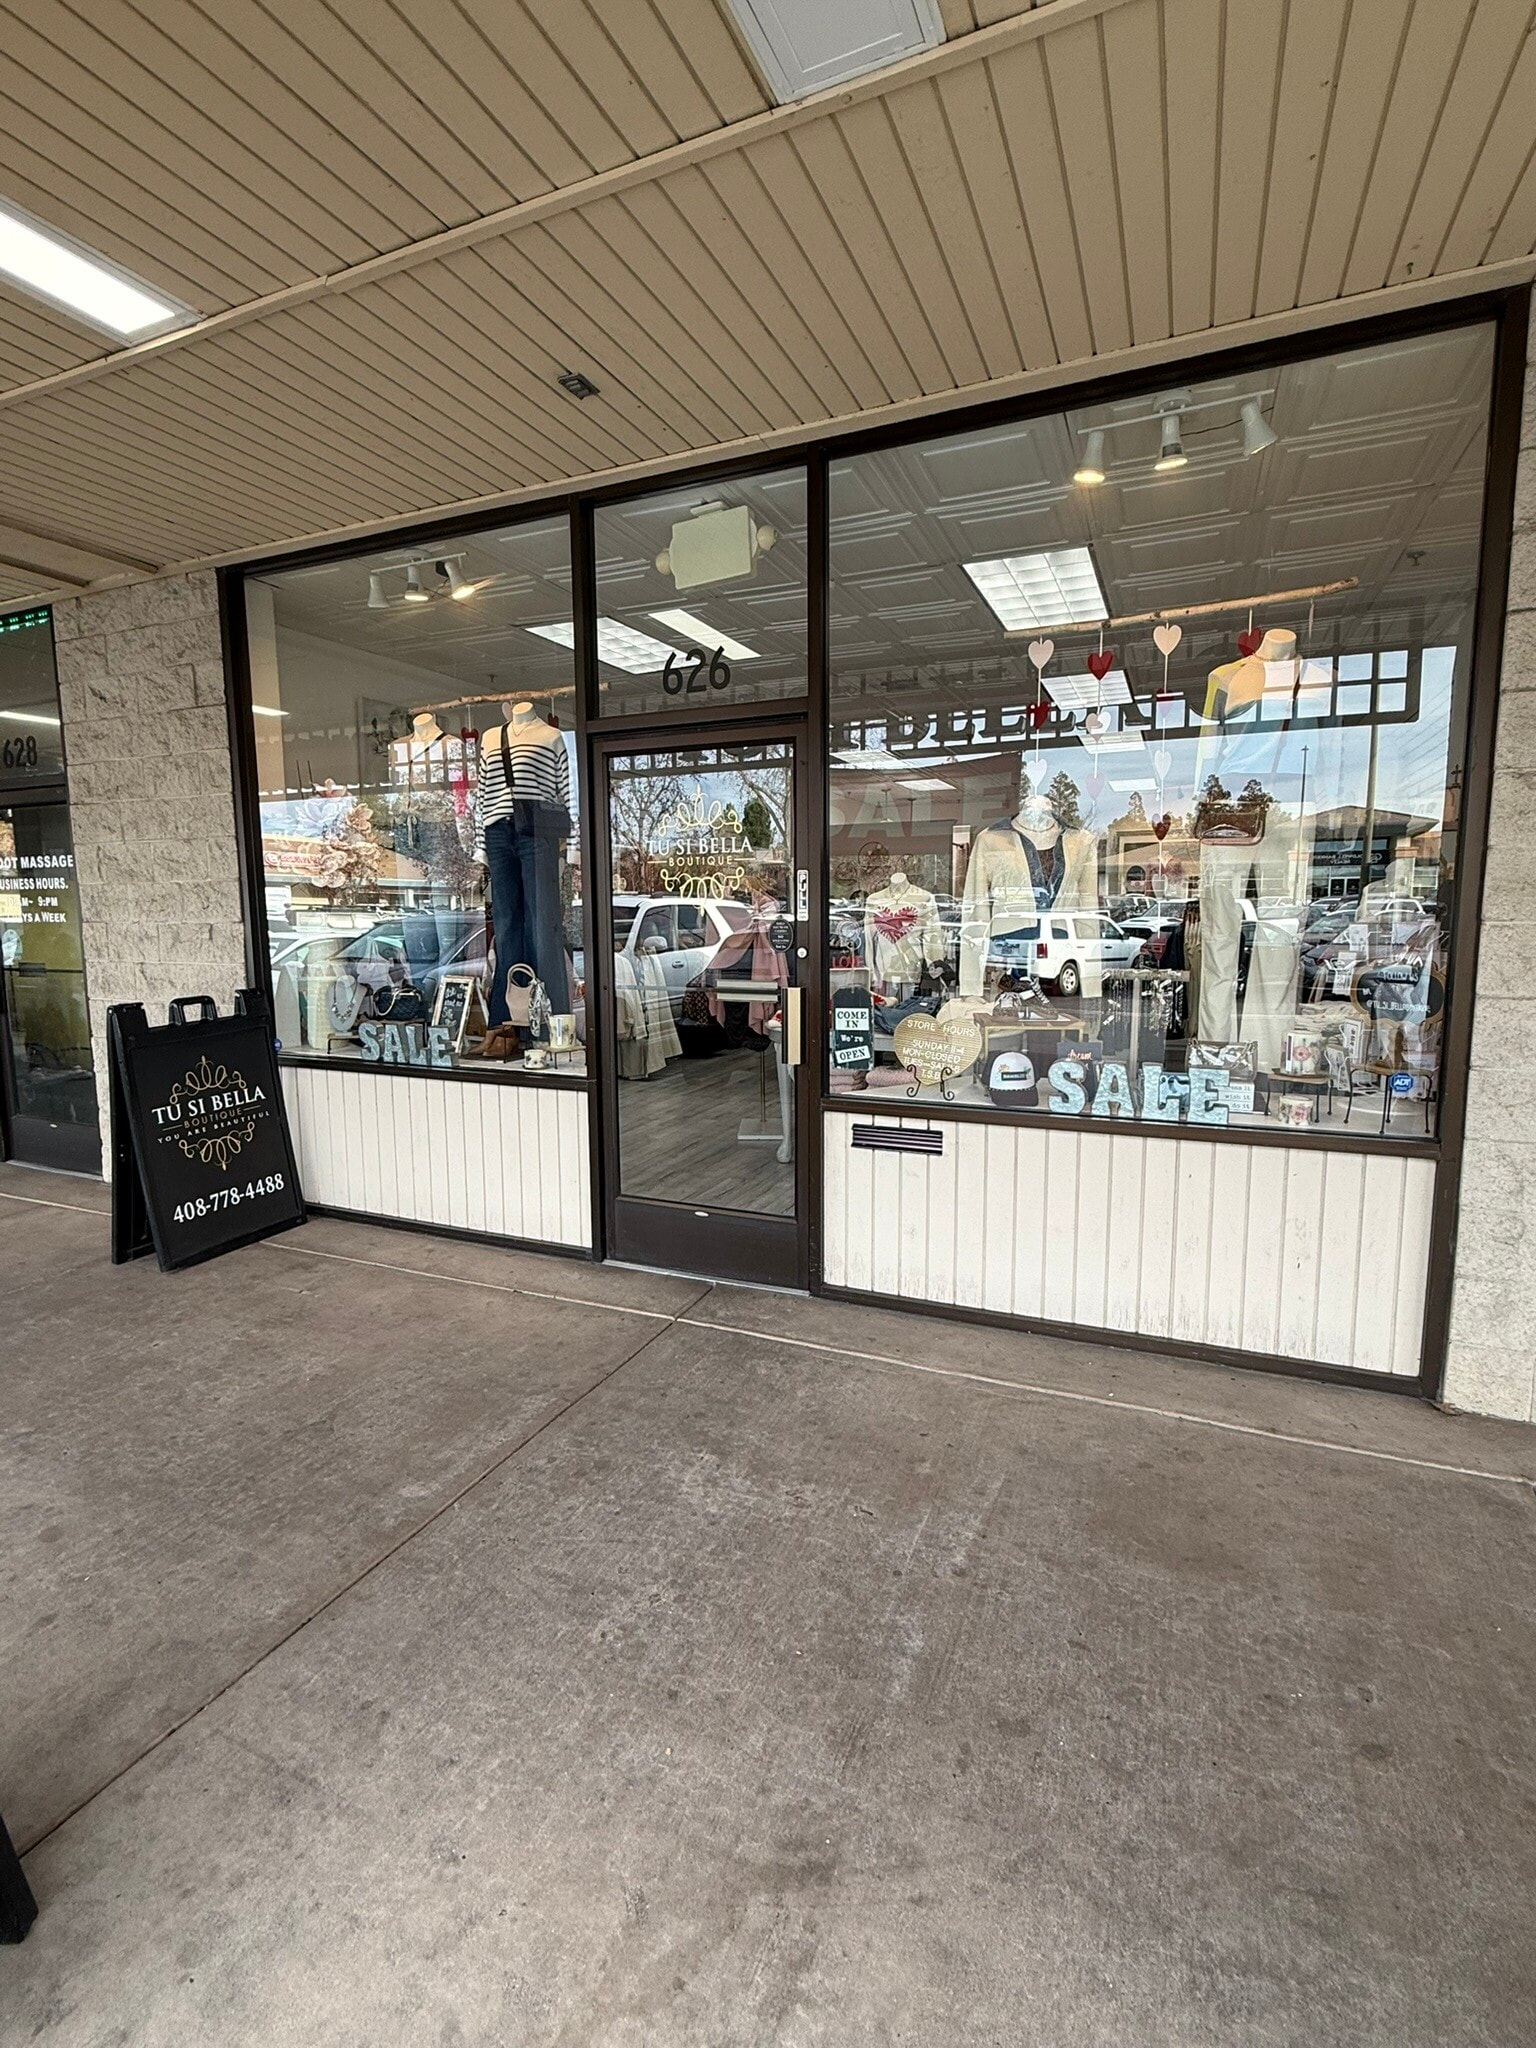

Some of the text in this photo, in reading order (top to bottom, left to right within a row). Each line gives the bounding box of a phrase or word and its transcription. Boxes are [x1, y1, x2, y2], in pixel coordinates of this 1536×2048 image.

[663, 645, 731, 695] 626
[3, 735, 38, 769] 628
[645, 836, 754, 856] TU SI BELLA
[20, 855, 74, 869] MASSAGE
[668, 855, 733, 867] BOUTIQUE
[799, 874, 807, 910] PULL
[34, 912, 41, 923] A
[41, 911, 67, 923] WEEK
[836, 1010, 867, 1020] COME
[845, 1020, 859, 1028] IN
[840, 1034, 864, 1042] We're
[907, 1019, 976, 1038] STORE HOURS
[359, 1022, 452, 1067] SALE
[913, 1039, 948, 1053] SUNDAY
[839, 1048, 866, 1061] OPEN
[902, 1047, 961, 1064] MON-CLOSED
[1394, 1078, 1411, 1086] ADT
[1048, 1061, 1229, 1125] SALE
[151, 1085, 266, 1124] TU SI BELLA
[157, 1110, 270, 1144] YOU ARE BEAUTIFUL
[184, 1108, 242, 1129] BOUTIQUE
[173, 1173, 285, 1223] 408-778-4488
